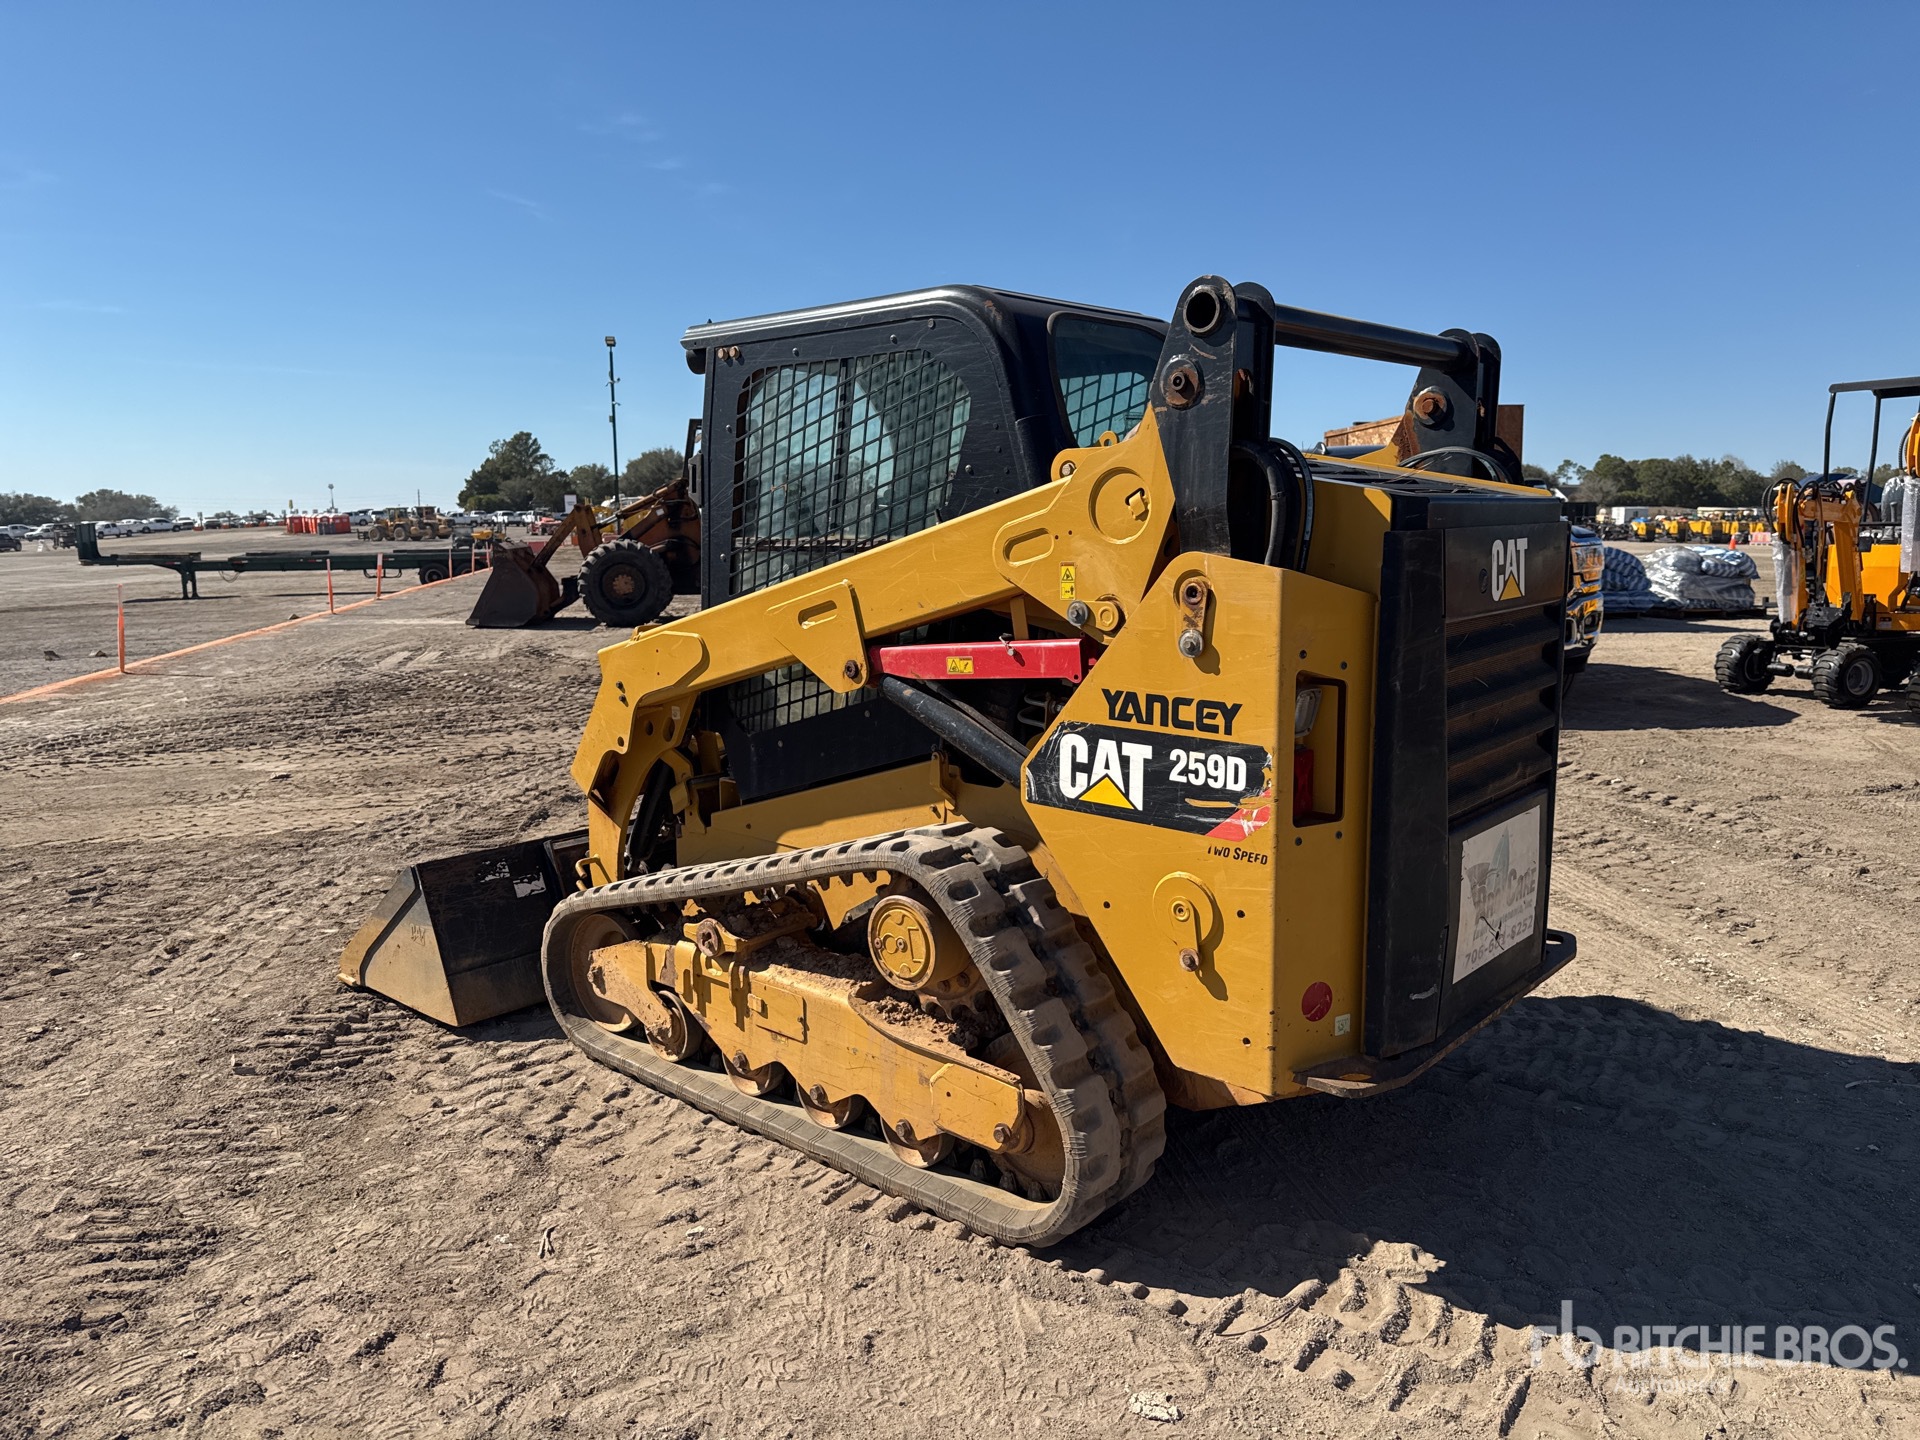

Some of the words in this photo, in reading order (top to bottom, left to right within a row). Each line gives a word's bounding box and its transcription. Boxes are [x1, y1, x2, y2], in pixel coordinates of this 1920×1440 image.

[1491, 537, 1528, 602] CAT
[1101, 688, 1243, 735] YANCEY
[1059, 733, 1152, 811] CAT
[1169, 748, 1247, 792] 259D
